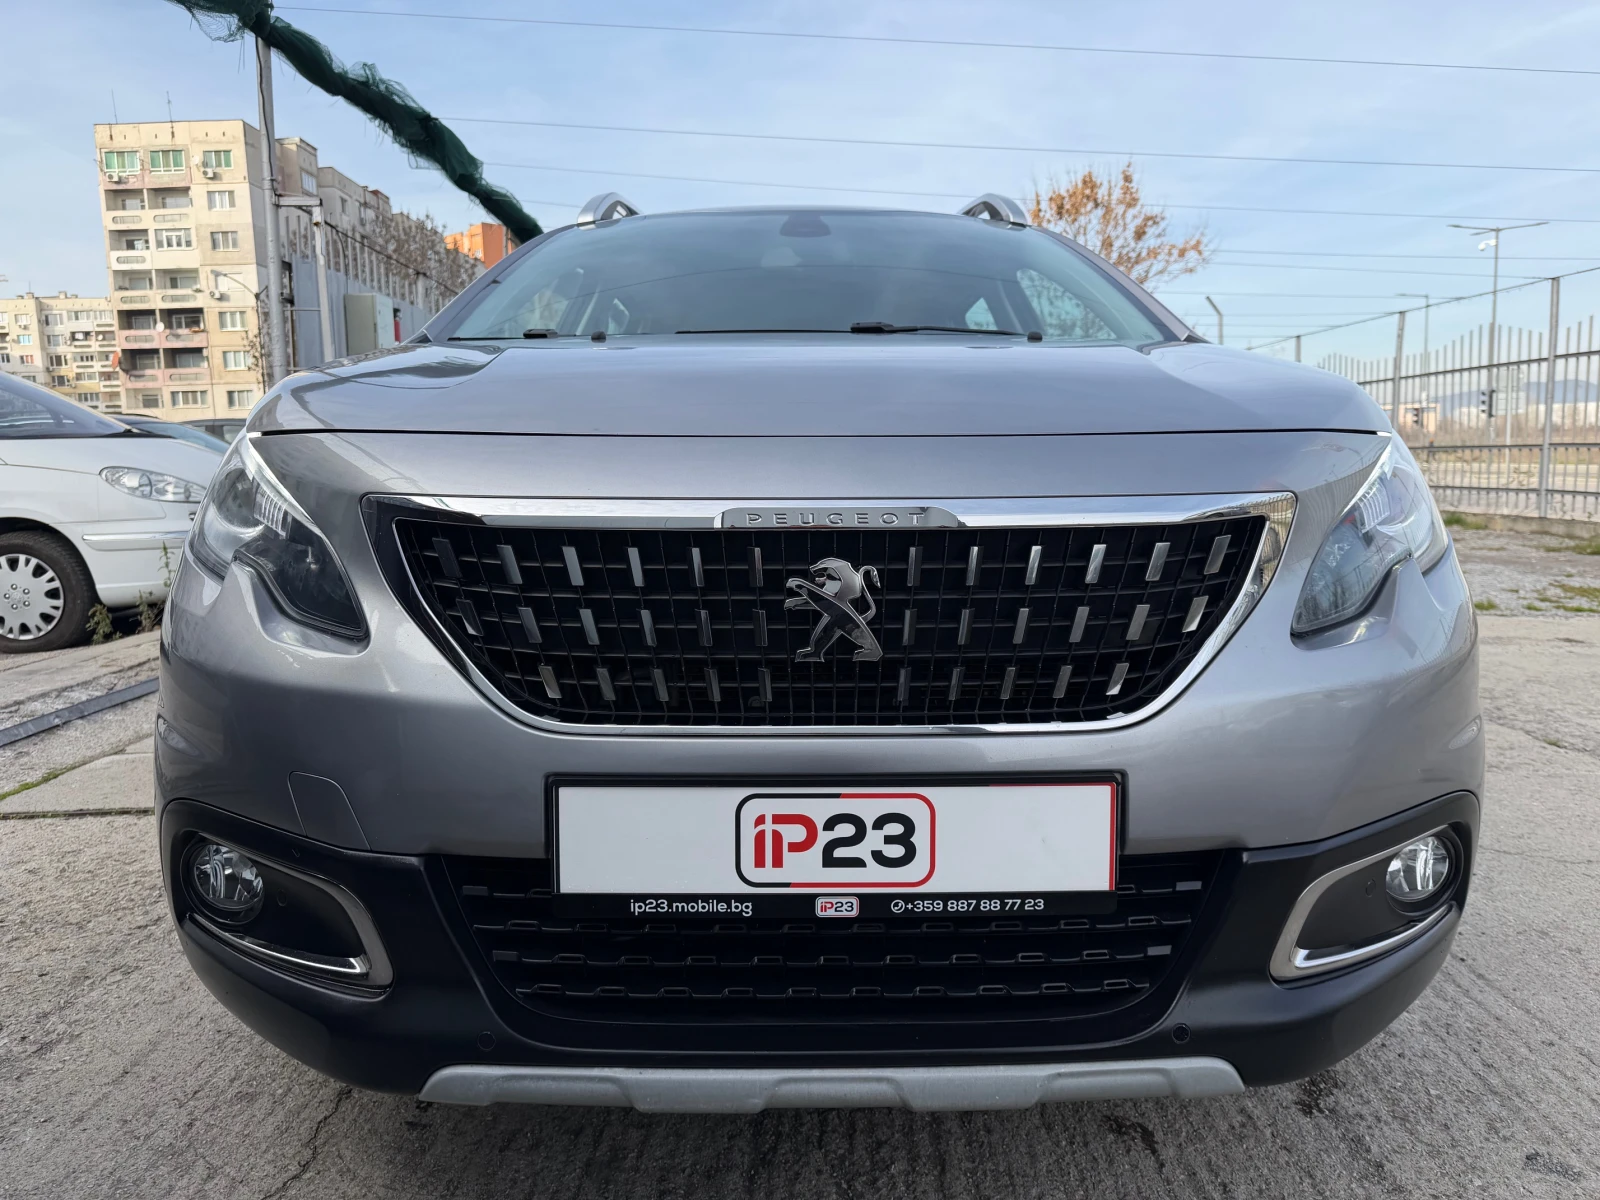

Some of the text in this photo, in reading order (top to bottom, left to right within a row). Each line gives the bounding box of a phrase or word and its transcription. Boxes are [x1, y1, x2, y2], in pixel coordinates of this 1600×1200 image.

[746, 512, 925, 526] PEUGEOT
[630, 899, 753, 917] ip23.mobile.bg
[906, 899, 1045, 912] +359 887 88 77 23
